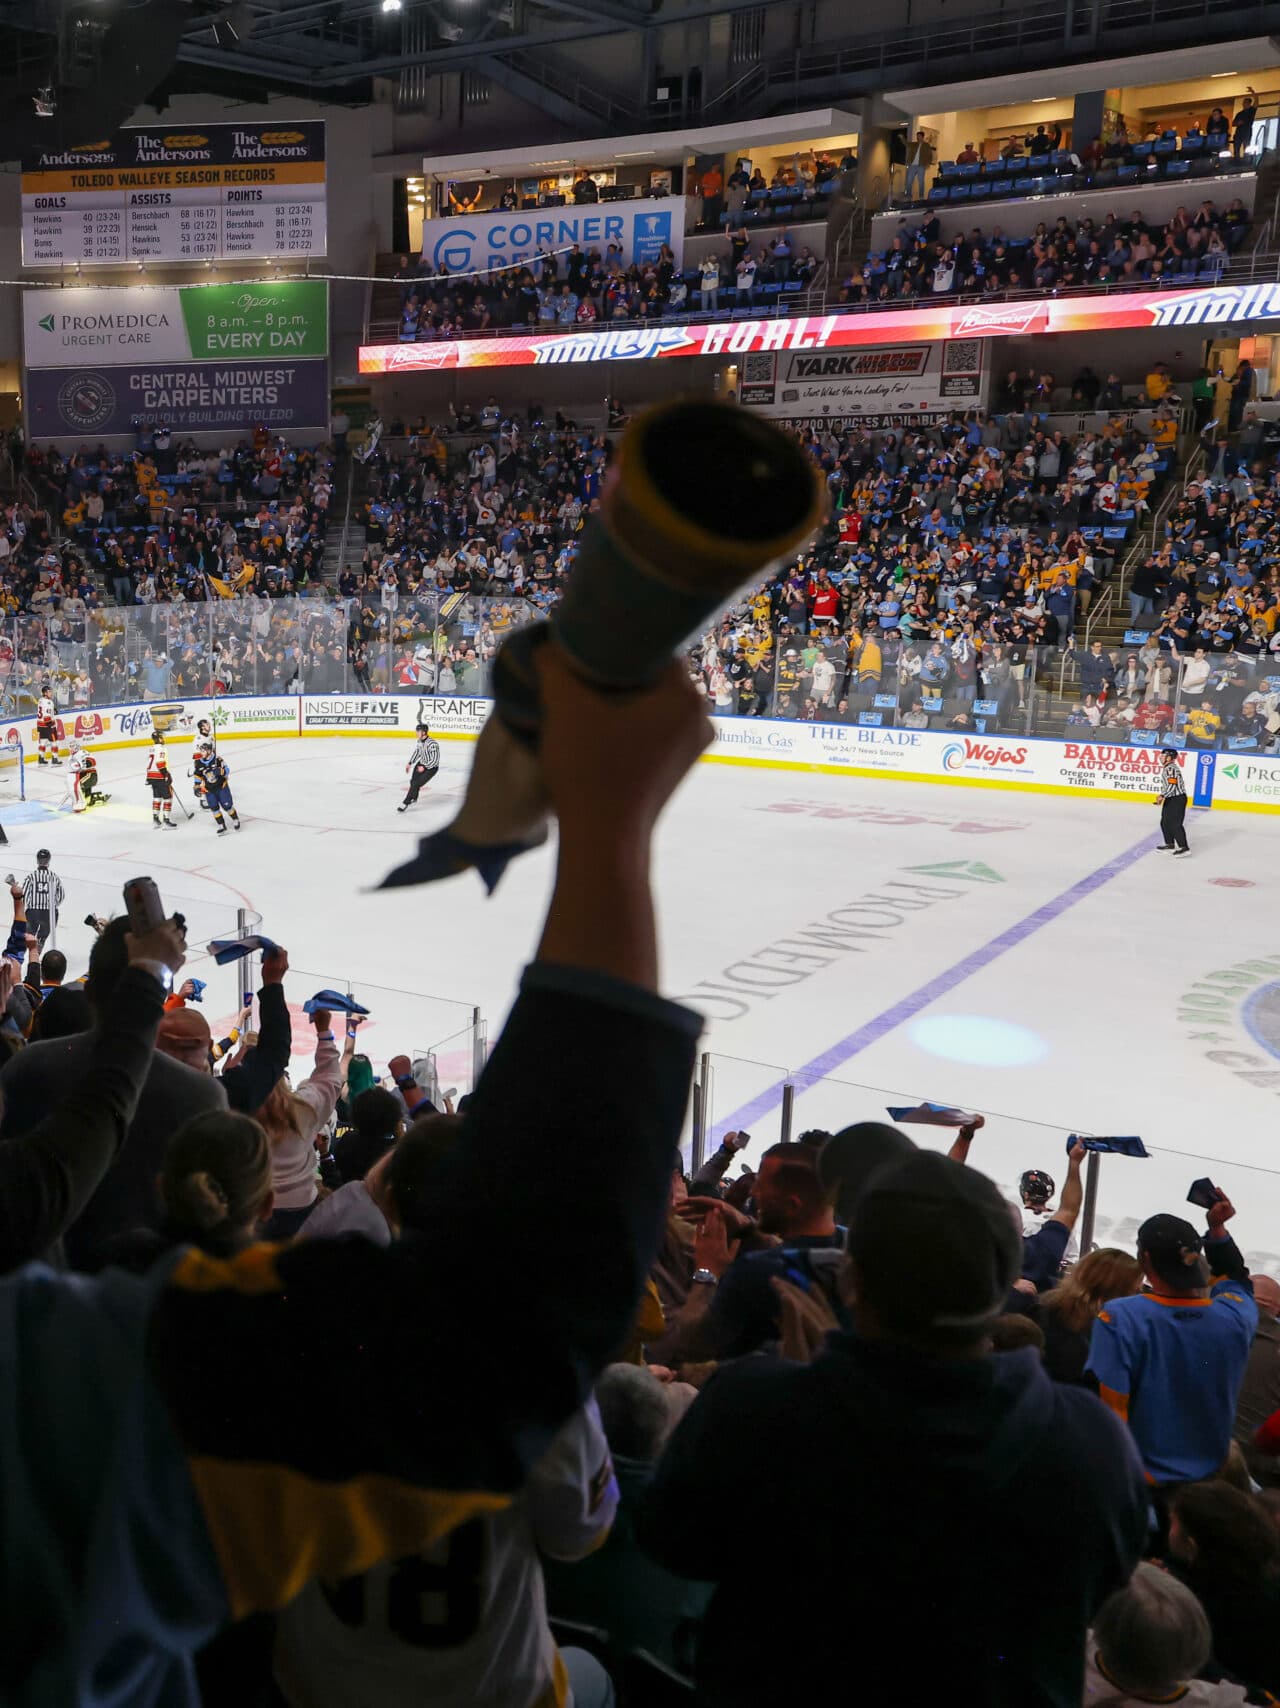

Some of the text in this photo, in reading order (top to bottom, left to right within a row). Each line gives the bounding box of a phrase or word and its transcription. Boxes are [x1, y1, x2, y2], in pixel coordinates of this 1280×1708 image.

[135, 132, 259, 149] The The
[135, 147, 212, 162] Andersons
[231, 143, 308, 158] Andersons
[39, 151, 116, 166] Andersons
[70, 168, 276, 188] TOLEDO WALLEYE SEASON RECORDS
[34, 196, 67, 209] GOALS
[130, 193, 172, 205] ASSISTS
[227, 190, 263, 201] POINTS
[487, 215, 625, 249] CORNER
[34, 250, 63, 259] Hawkins
[236, 293, 280, 313] Open
[61, 313, 170, 331] PROMEDICA
[207, 313, 309, 330] 8 a.m. 8 p.m.
[62, 332, 152, 346] URGENT CARE
[207, 331, 307, 349] EVERY DAY
[701, 314, 839, 355] GOAL!
[795, 355, 857, 377] YARK
[129, 372, 209, 391] CENTRAL
[215, 369, 296, 387] MIDWEST
[144, 387, 278, 409] CARPENTERS
[803, 386, 820, 398] Just
[820, 386, 840, 398] What
[187, 409, 244, 424] BUILDING
[247, 408, 294, 421] TOLEDO
[232, 708, 297, 718] YELLOWSTONE
[305, 701, 354, 714] INSIDE
[417, 698, 487, 717] FRAME
[114, 708, 152, 736] Toft's
[424, 714, 478, 723] Chiropractic
[427, 722, 481, 731] Acupuncture
[767, 732, 794, 747] Gas
[808, 725, 922, 747] THE BLADE
[1076, 759, 1164, 775] AUTO GROU
[1059, 768, 1096, 779] Oregon
[1102, 772, 1147, 783] Fremont
[1068, 777, 1135, 790] Tiffin Port
[36, 883, 49, 894] 94
[670, 881, 969, 1022] PROMEDIC
